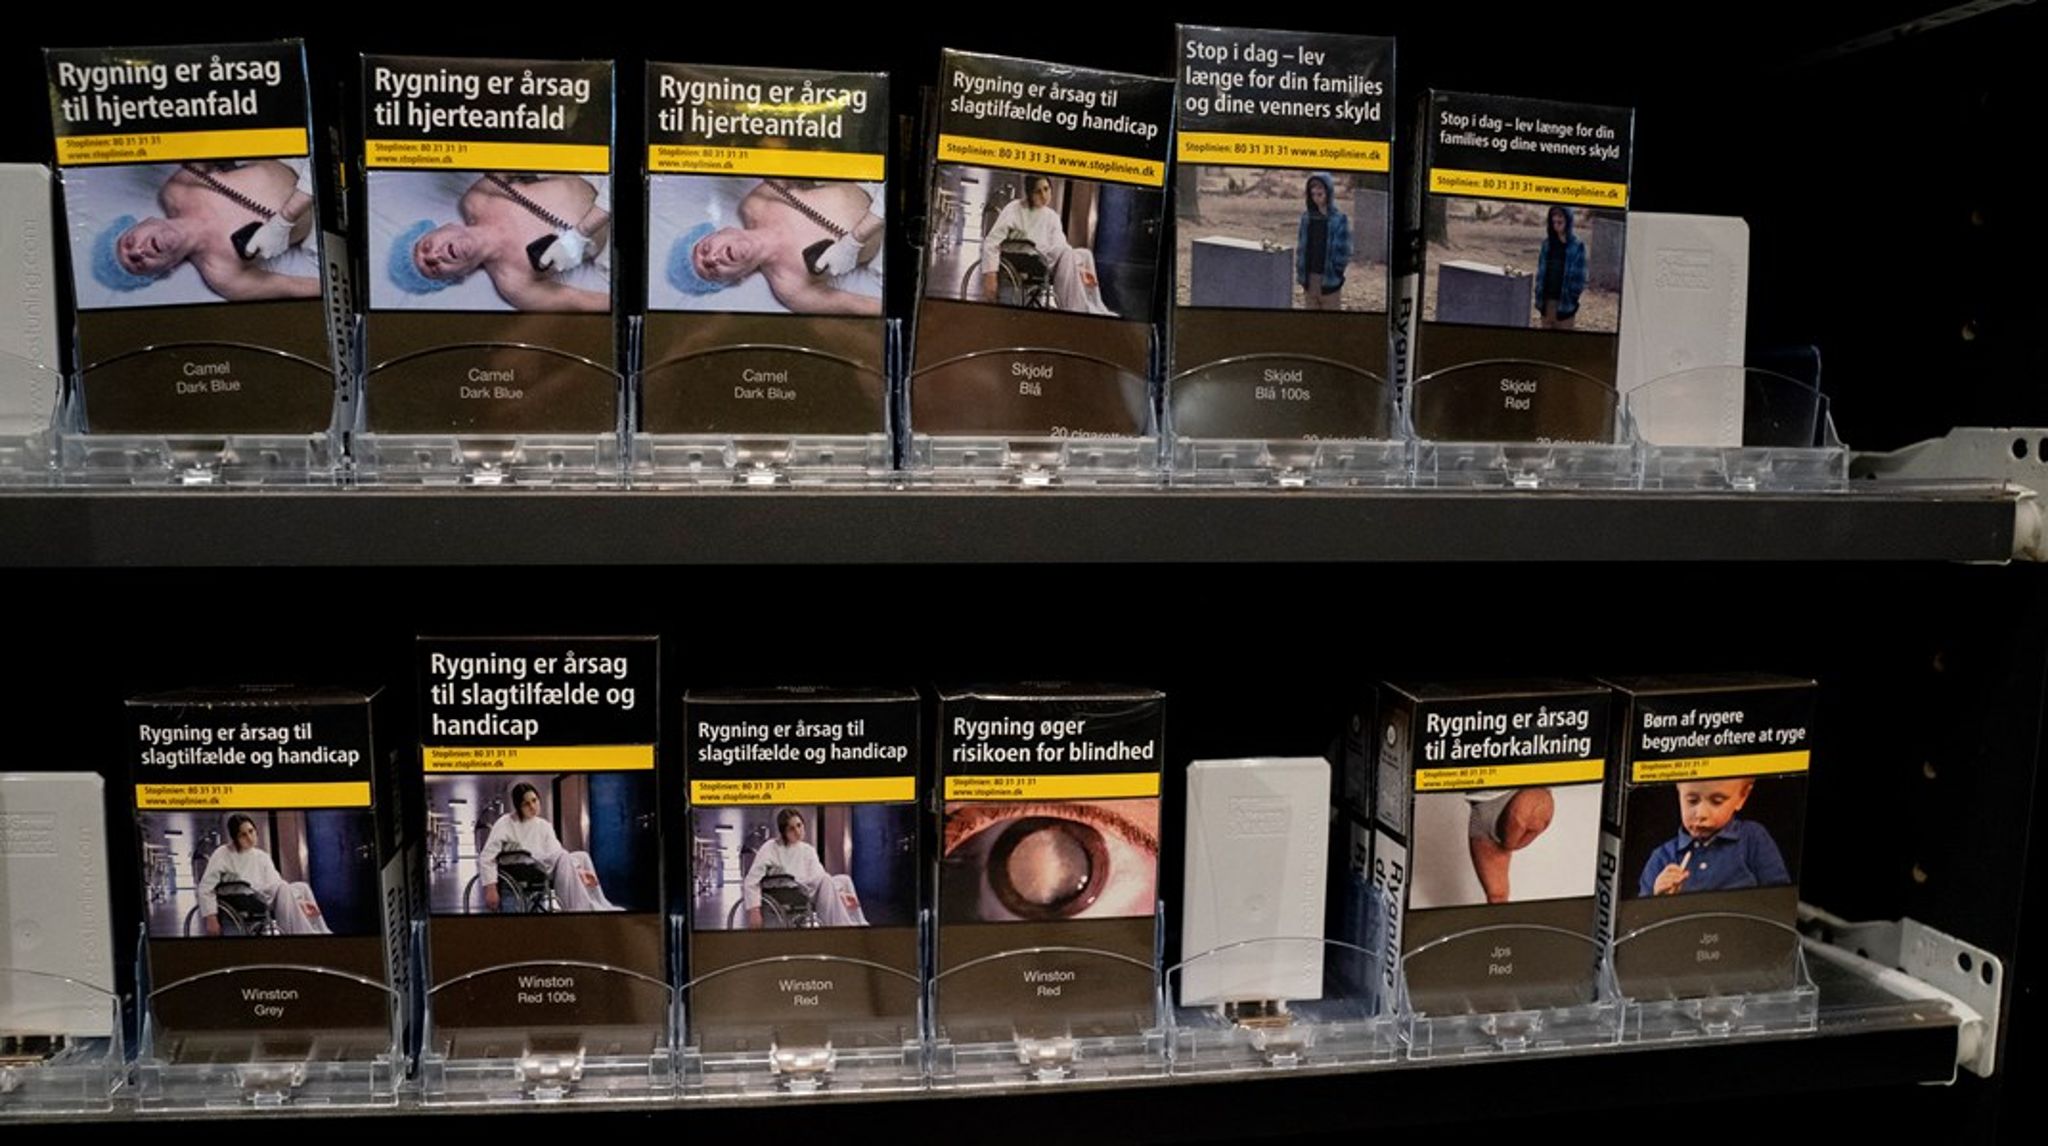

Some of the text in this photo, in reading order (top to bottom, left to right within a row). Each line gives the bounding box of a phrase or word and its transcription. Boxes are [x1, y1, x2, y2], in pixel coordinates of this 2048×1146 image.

[1186, 40, 1227, 64] Stop
[1234, 43, 1238, 60] i
[1244, 43, 1278, 67] dag
[1299, 46, 1325, 66] lev
[58, 55, 281, 93] Rygning er årsag
[375, 68, 590, 103] Rygning er årsag
[1186, 66, 1383, 95] længe for din families
[660, 75, 868, 113] Rygning er årsag
[953, 71, 1117, 108] Rygning er årsag til
[61, 89, 258, 127] til hjerteanfald
[374, 102, 564, 133] til hjerteanfald
[951, 96, 1158, 139] slagtilfælde og handicap
[1186, 94, 1381, 125] og dine venners skyld
[658, 107, 842, 139] til hjerteanfald
[1440, 112, 1469, 128] Stop
[1472, 115, 1476, 126] i
[1479, 115, 1502, 132] dag
[1515, 118, 1533, 132] lev
[1536, 120, 1574, 139] længe
[1576, 123, 1592, 137] for
[1596, 125, 1614, 139] din
[1185, 143, 1380, 161] Stoplinien: 80 31 31 31 www.stoplinien.dk
[1440, 131, 1619, 161] families og dine venners skyld
[947, 143, 1155, 177] Stoplinien: 80 31 31 31 www.stoplinien.dk
[184, 361, 230, 376] Camel
[468, 368, 514, 381] Camel
[742, 369, 788, 383] Camel
[1012, 363, 1053, 379] Skjold
[1264, 369, 1302, 384] Skjold
[176, 380, 240, 394] Dark Blue
[460, 386, 523, 399] Dark Blue
[734, 386, 796, 400] Dark Blue
[1019, 382, 1042, 396] Blå
[1255, 386, 1310, 400] Blå 100s
[1501, 379, 1537, 394] Skjold
[1505, 398, 1531, 410] Rød
[1051, 426, 1132, 440] 20 cigarett
[431, 650, 627, 679] Rygning er årsag
[431, 682, 634, 710] til slagtilfælde og
[433, 713, 539, 740] handicap
[954, 717, 1085, 740] Rygning øger
[1427, 706, 1589, 738] Rygning er årsag
[1644, 709, 1744, 728] Børn af rygere
[140, 722, 312, 745] Rygning er årsag til
[699, 719, 864, 742] Rygning er årsag til
[1642, 727, 1806, 753] begynder oftere at ryge
[141, 746, 360, 769] slagtilfælde og handicap
[698, 742, 907, 765] slagtilfælde og handicap
[953, 740, 1154, 762] risikoen for blindhed
[1425, 734, 1591, 760] til åreforkalkning
[518, 976, 574, 988] Winston
[779, 980, 833, 991] Winston
[1024, 971, 1075, 982] Winston
[241, 989, 298, 1000] Winston
[518, 991, 576, 1003] Red 100s
[1037, 985, 1061, 996] Red
[254, 1004, 284, 1018] Grey
